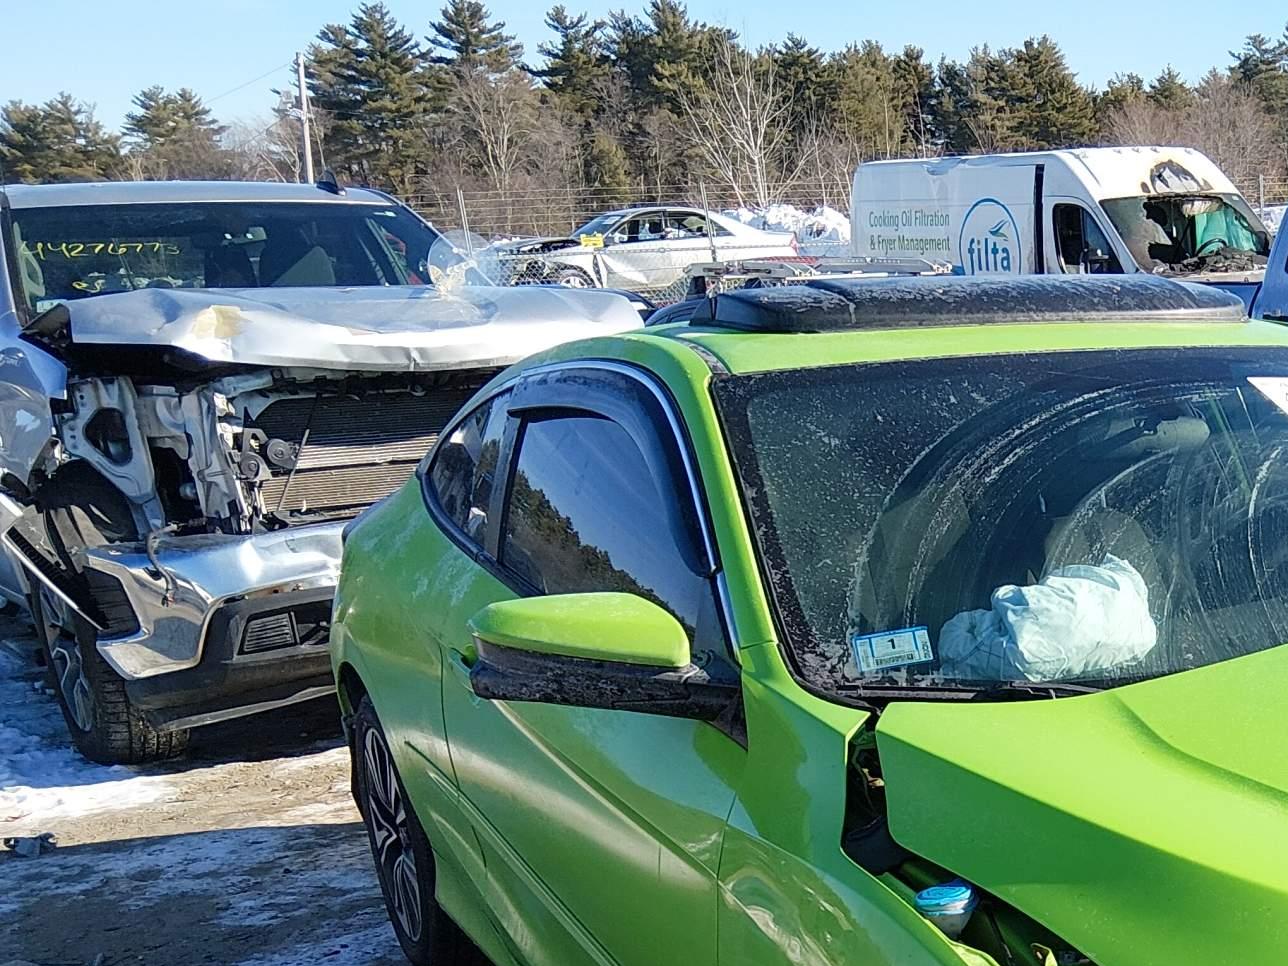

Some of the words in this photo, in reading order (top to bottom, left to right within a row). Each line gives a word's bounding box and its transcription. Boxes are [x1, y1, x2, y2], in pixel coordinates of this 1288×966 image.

[869, 211, 899, 231] Cooking
[901, 211, 912, 227] Oil
[914, 211, 950, 227] Filtration
[869, 236, 876, 250] &
[877, 235, 896, 255] Fryer
[898, 235, 951, 255] Management
[968, 238, 1011, 275] filta
[887, 638, 896, 650] 1
